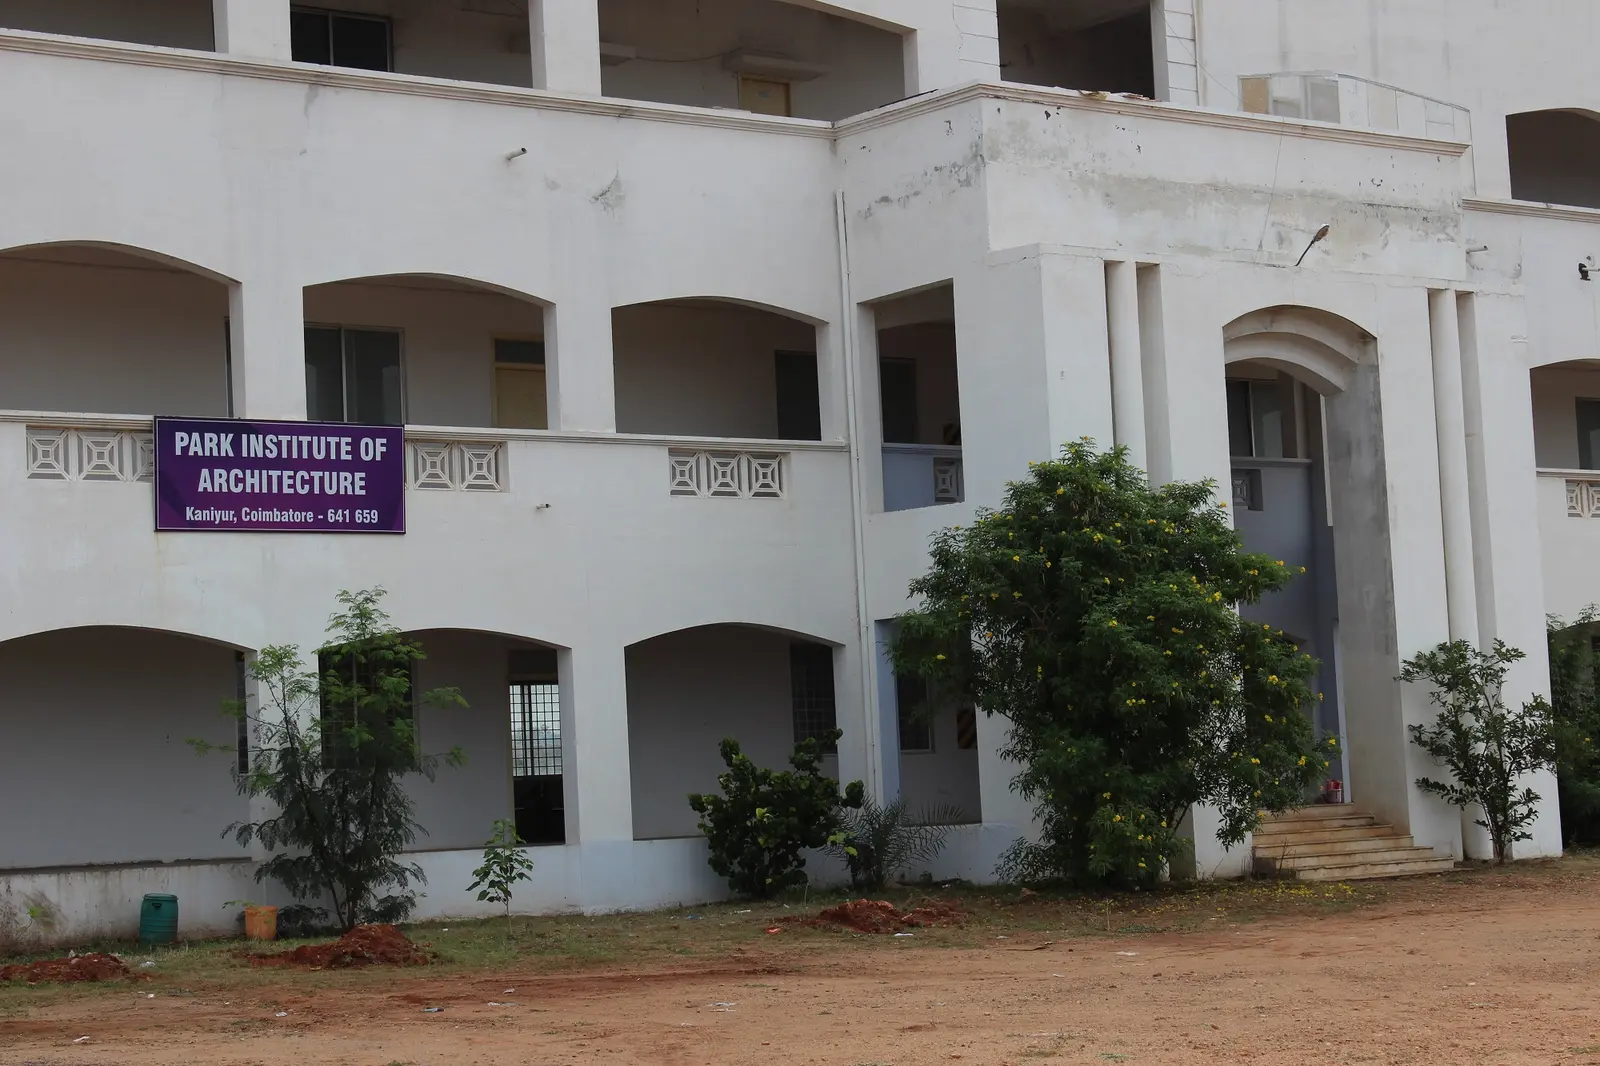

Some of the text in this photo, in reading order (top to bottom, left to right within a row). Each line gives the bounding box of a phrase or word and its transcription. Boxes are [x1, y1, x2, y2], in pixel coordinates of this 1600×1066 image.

[175, 431, 387, 462] PARK INSTITUTE OF
[197, 468, 366, 496] ARCHITECTURE
[186, 506, 238, 525] Kaniyur,
[241, 506, 314, 523] Coimbatore
[327, 508, 350, 523] 641
[355, 509, 379, 524] 659
